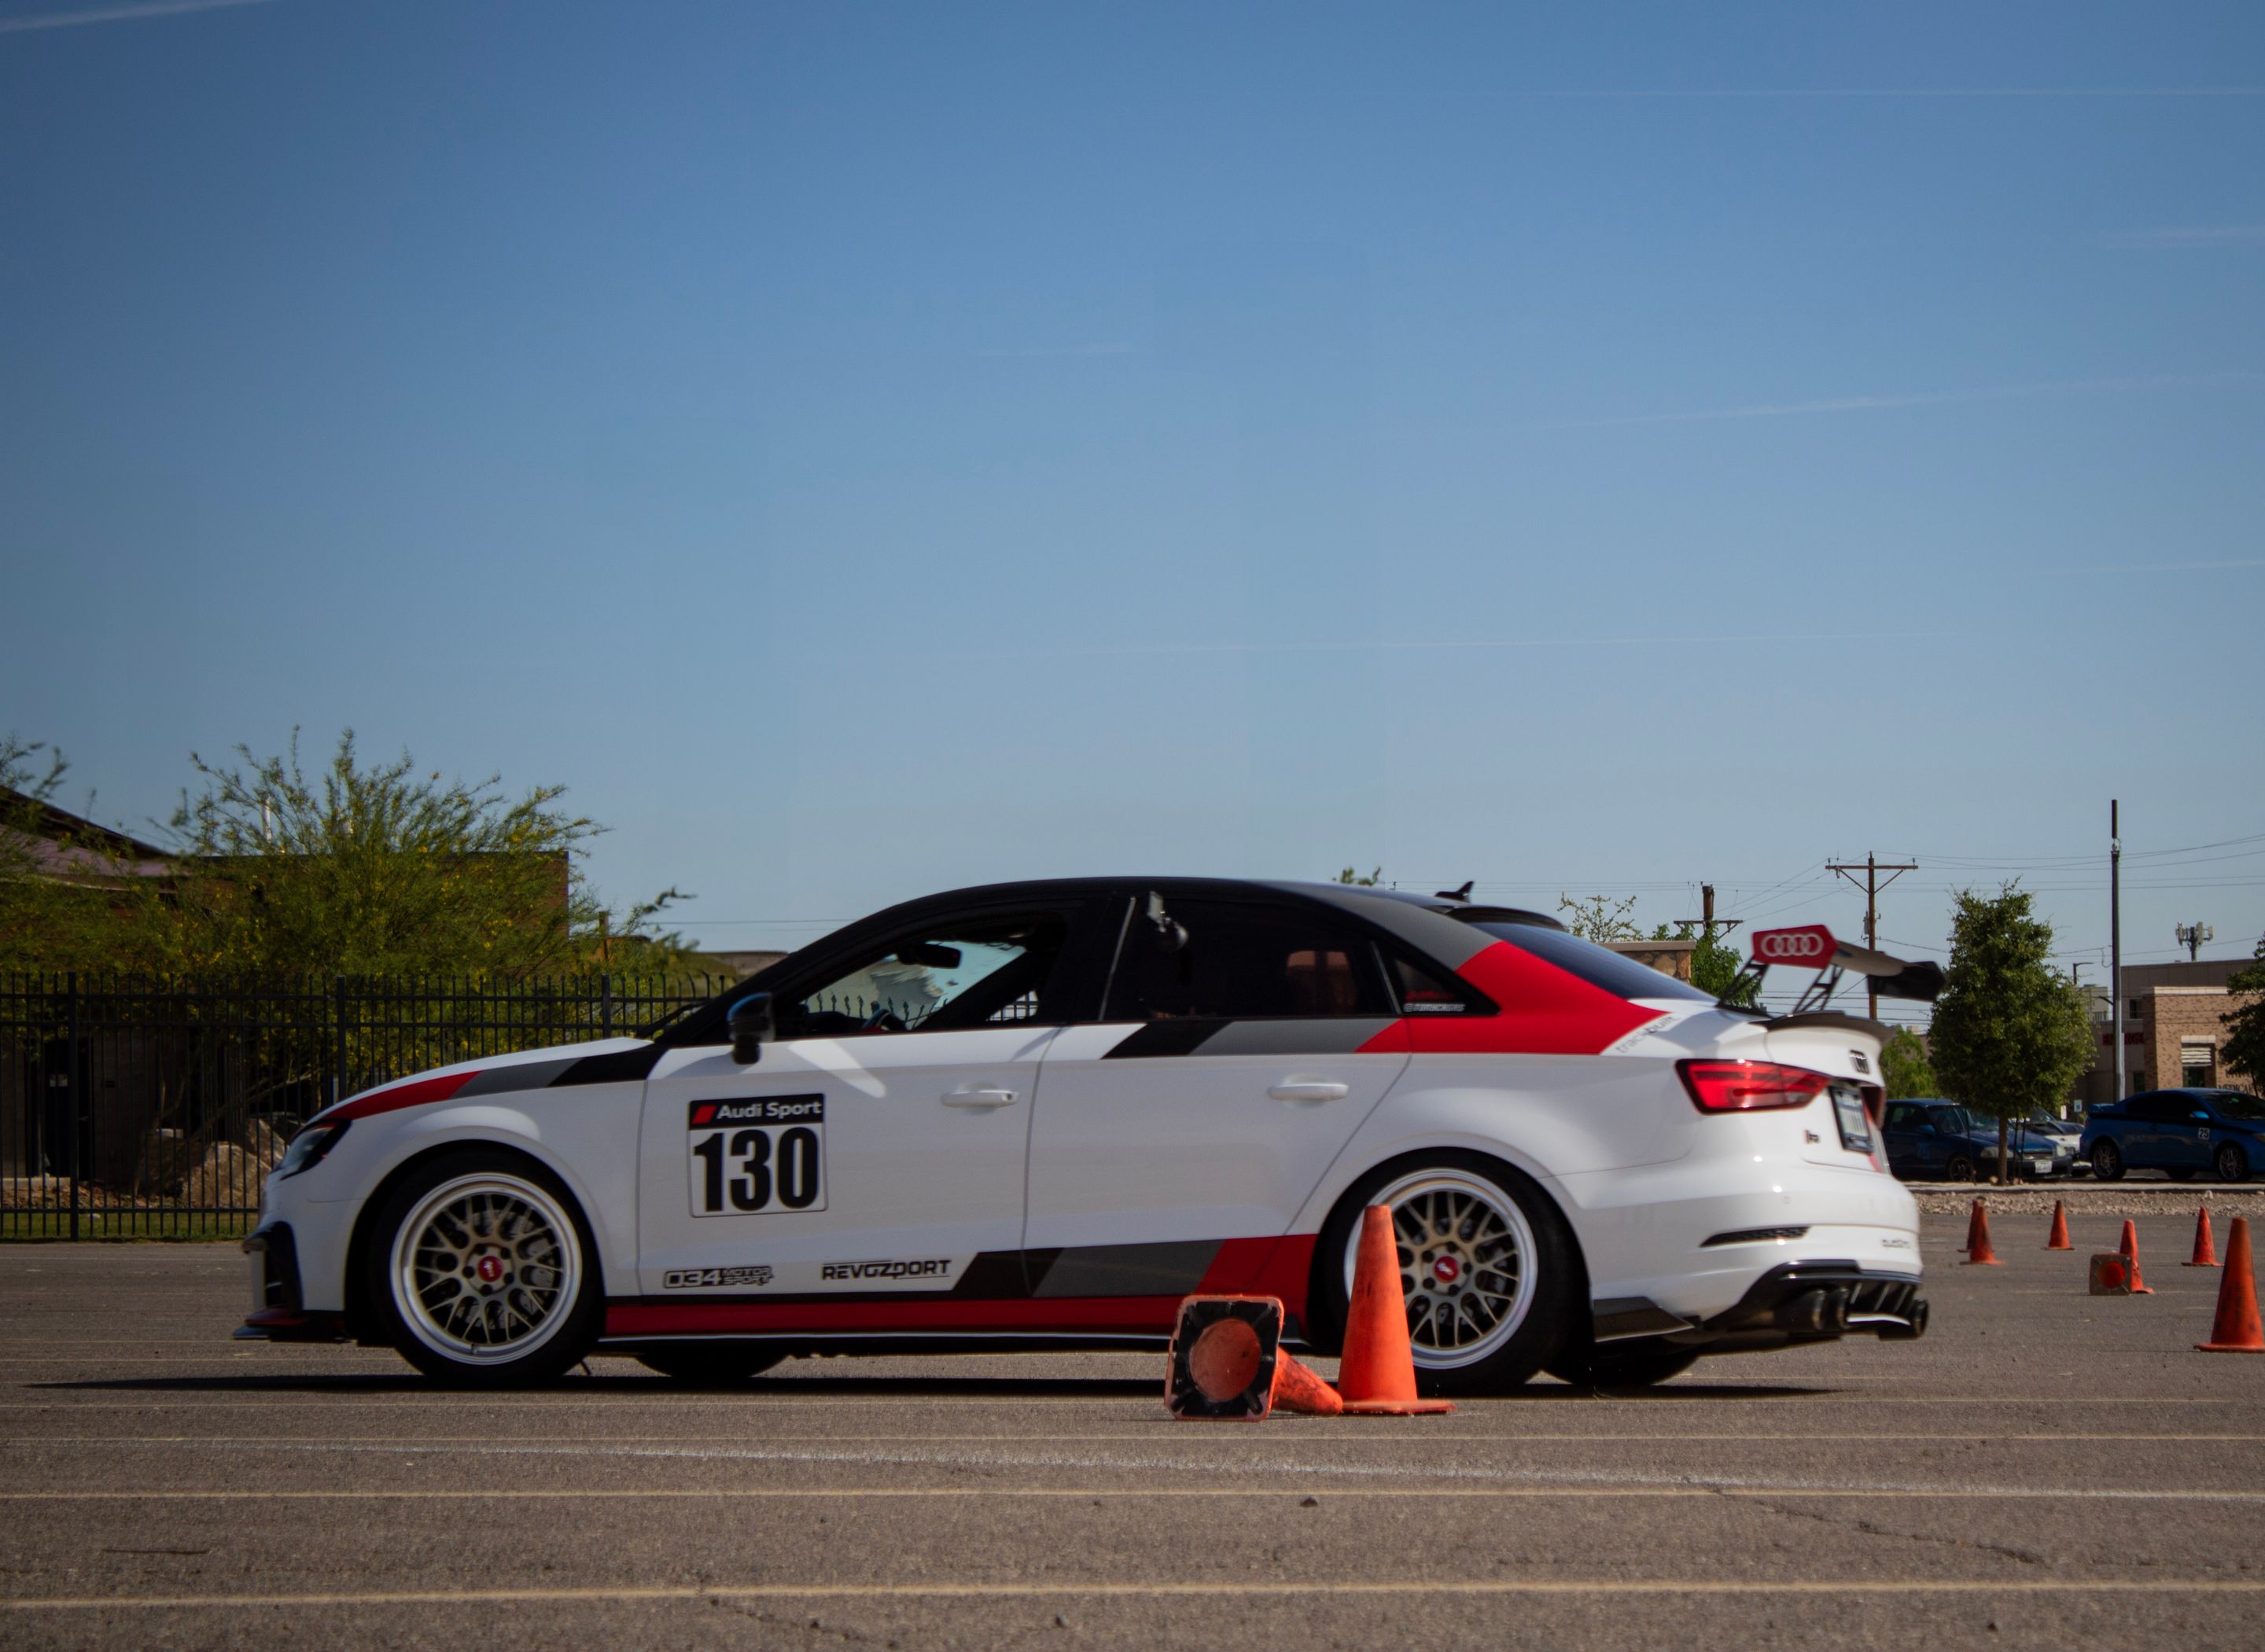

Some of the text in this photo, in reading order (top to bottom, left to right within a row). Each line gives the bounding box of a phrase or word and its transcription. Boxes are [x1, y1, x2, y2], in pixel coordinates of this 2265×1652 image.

[716, 1102, 823, 1120] Audi Sport
[693, 1126, 819, 1212] 130
